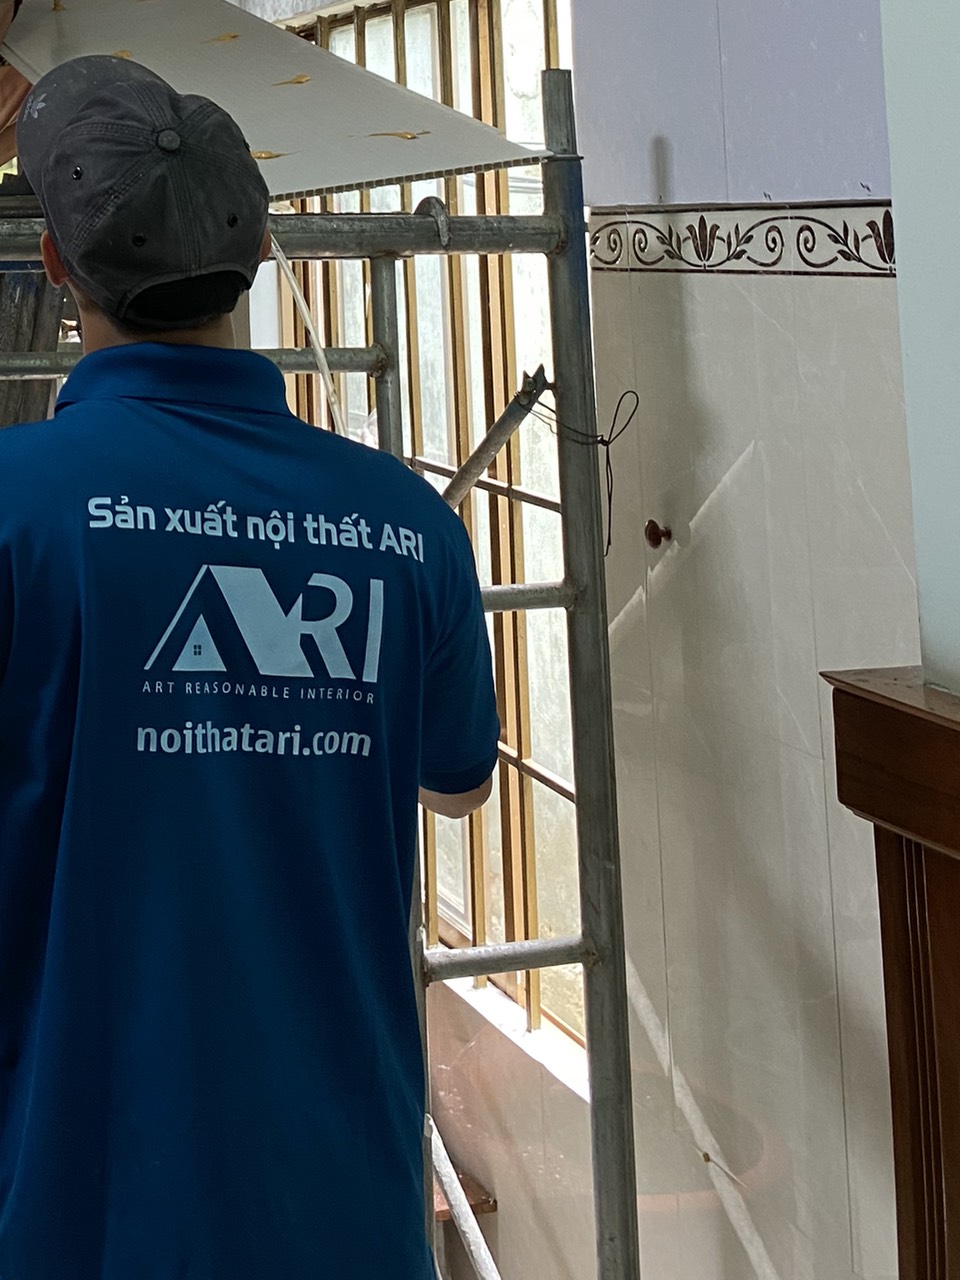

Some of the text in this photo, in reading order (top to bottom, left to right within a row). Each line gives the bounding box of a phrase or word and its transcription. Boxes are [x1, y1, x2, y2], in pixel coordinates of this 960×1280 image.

[87, 495, 424, 563] Sản xuất nội thất ARI
[142, 681, 374, 704] ART REASONABLE INTERIOR
[137, 721, 372, 757] noithatari.com
